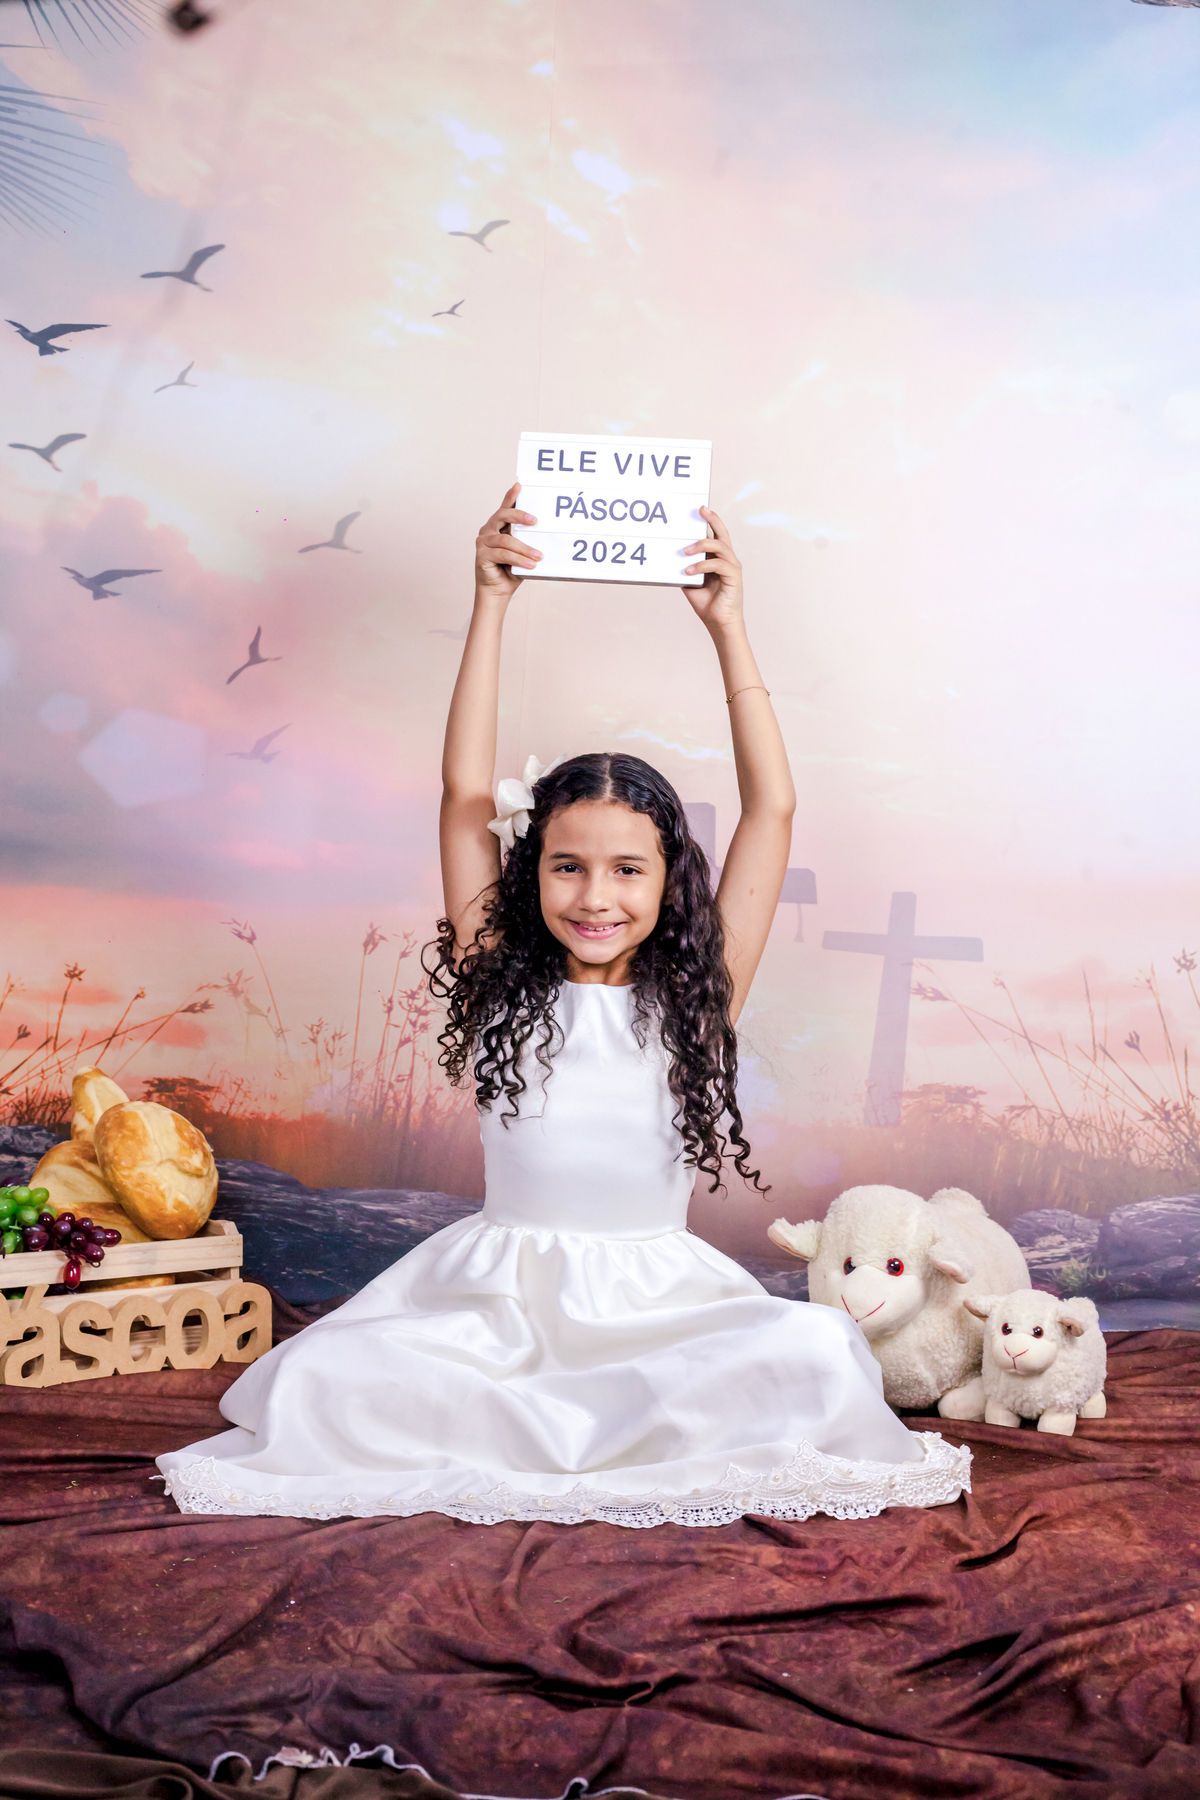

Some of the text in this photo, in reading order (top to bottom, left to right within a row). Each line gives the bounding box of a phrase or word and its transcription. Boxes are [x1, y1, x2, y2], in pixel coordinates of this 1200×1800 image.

[537, 449, 692, 478] ELE VIVE
[555, 491, 668, 524] PÁSCOA
[571, 539, 647, 566] 2024
[0, 1282, 272, 1388] áscoa
